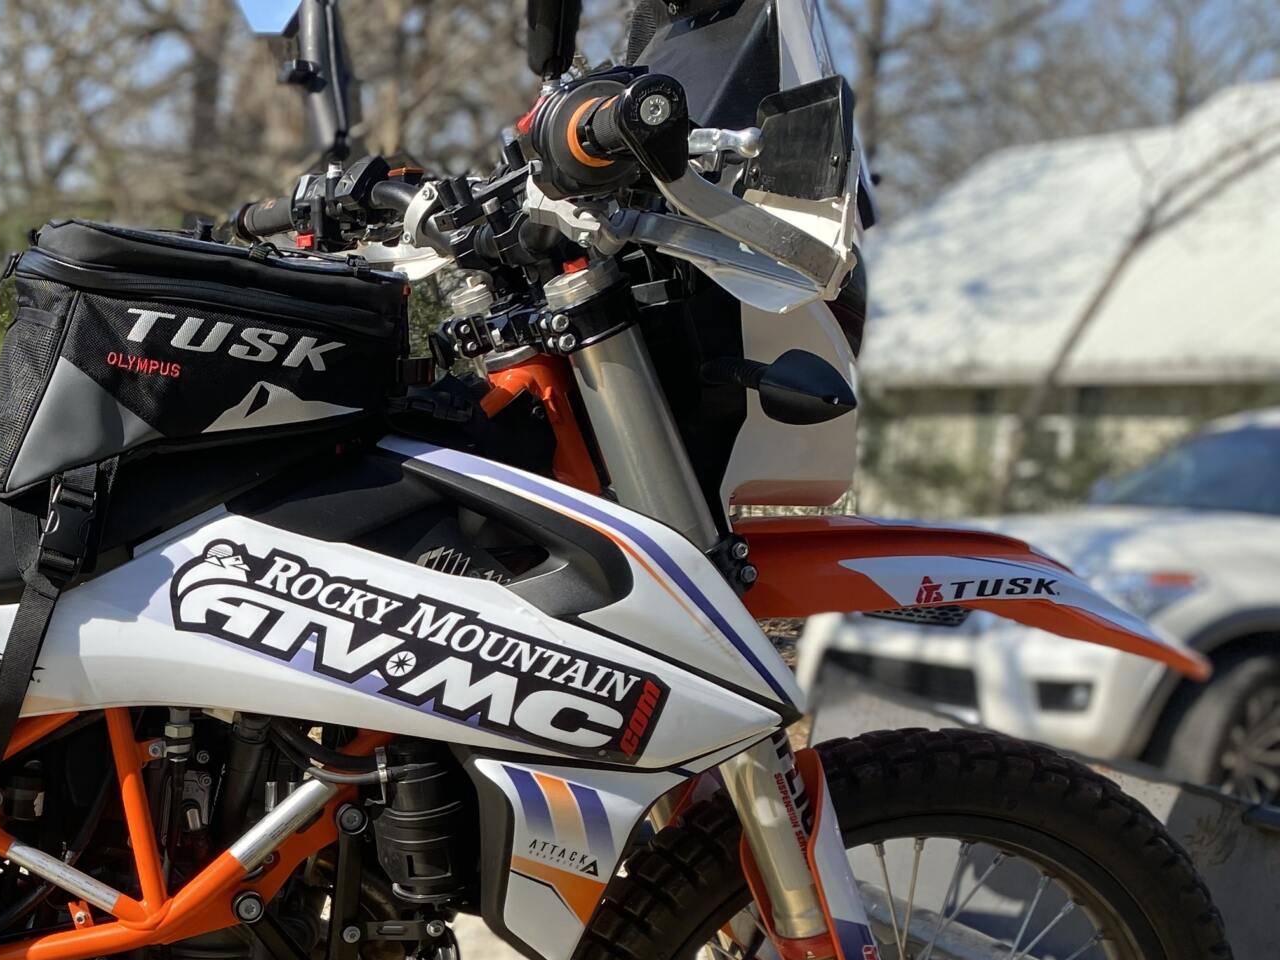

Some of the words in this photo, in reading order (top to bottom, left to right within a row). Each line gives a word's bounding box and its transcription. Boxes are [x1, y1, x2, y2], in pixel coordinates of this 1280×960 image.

[127, 308, 346, 371] TUSK
[107, 352, 183, 379] OLYMPUS
[951, 578, 1059, 600] TUSK
[255, 555, 404, 626] ROCKY
[399, 601, 642, 703] MOUNTAIN
[529, 839, 588, 865] ATTACK
